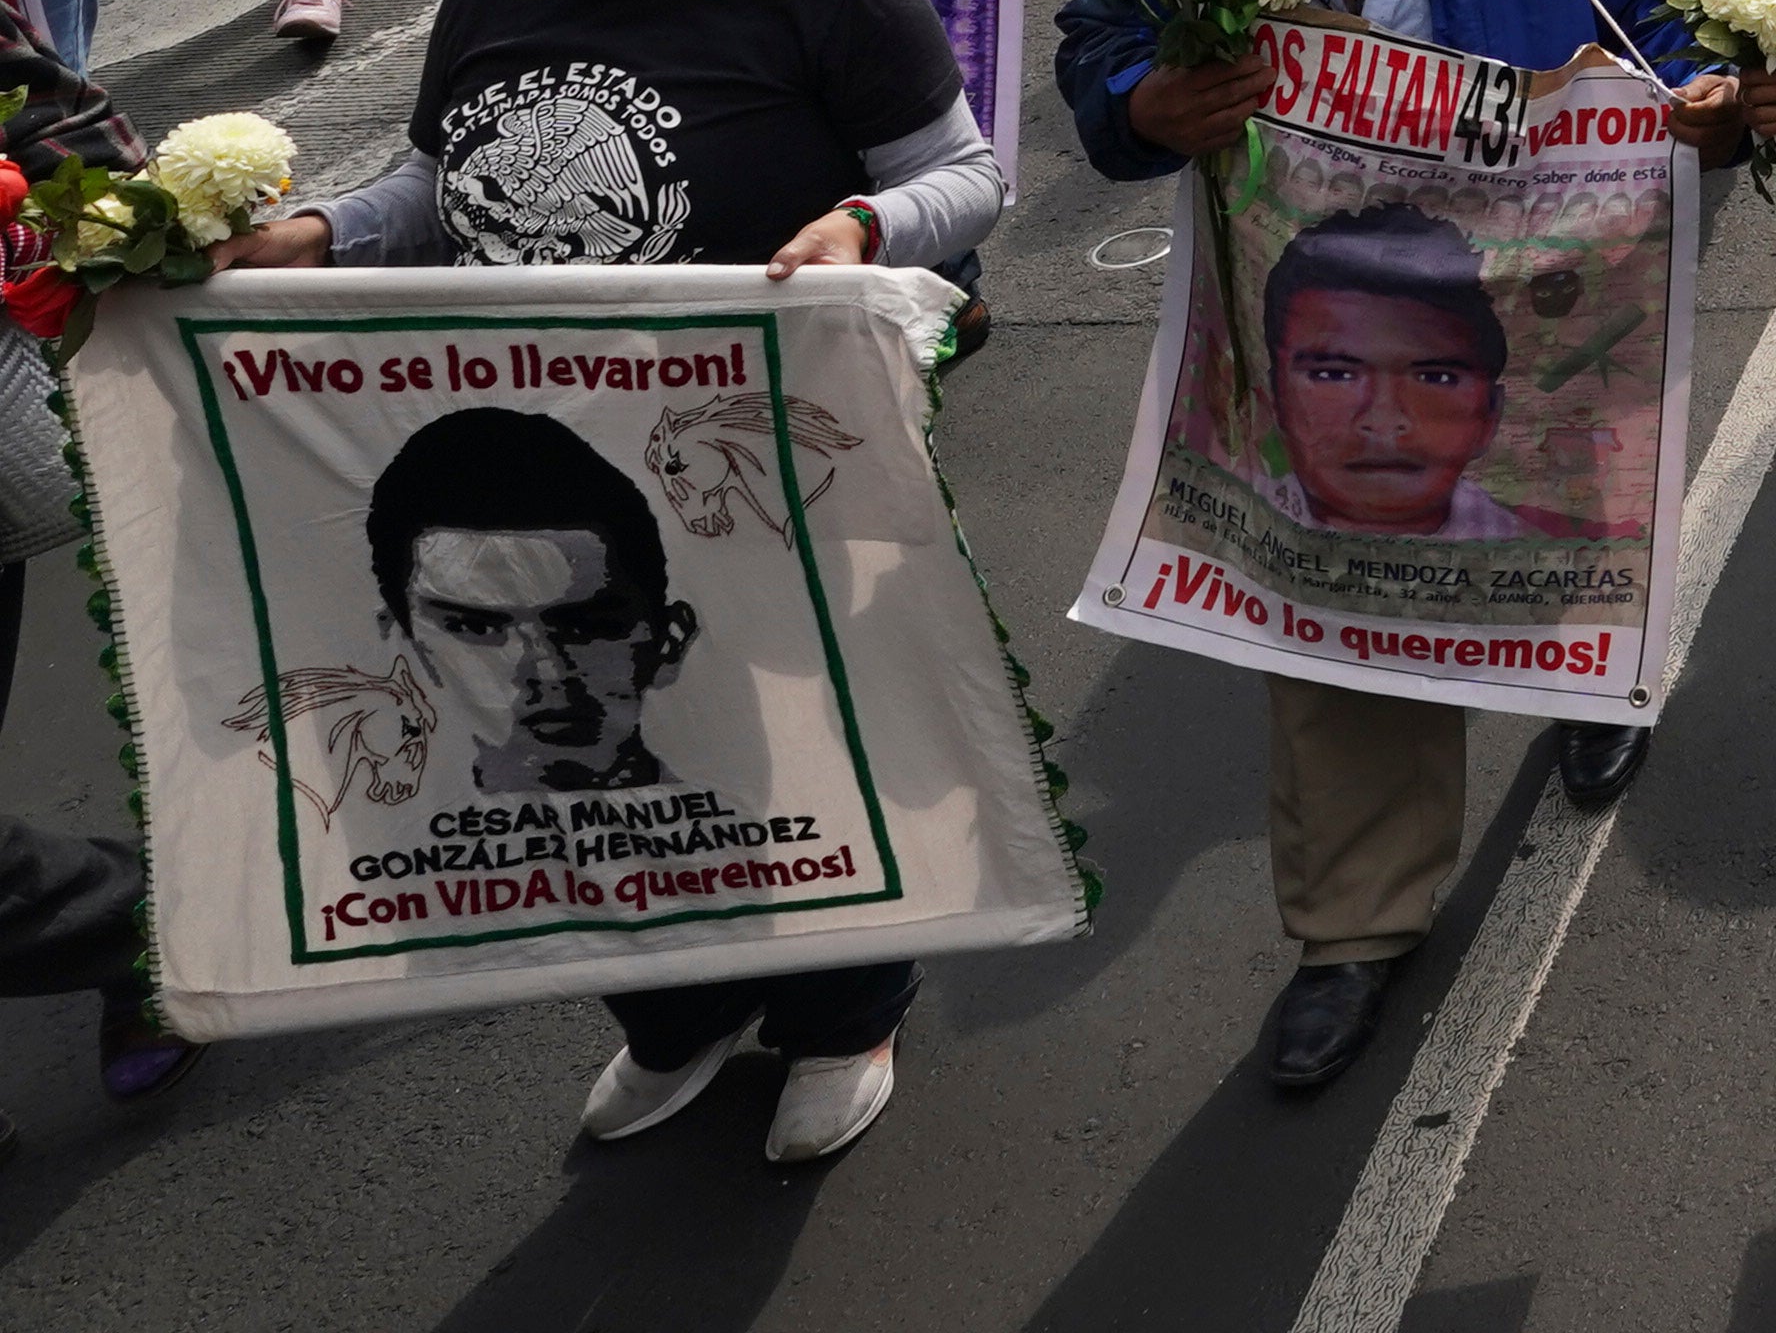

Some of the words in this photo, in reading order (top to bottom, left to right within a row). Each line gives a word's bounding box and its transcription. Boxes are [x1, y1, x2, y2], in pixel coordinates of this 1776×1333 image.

[441, 80, 507, 134] FUE
[517, 65, 557, 94] EL
[565, 61, 682, 130] ESTADO
[554, 83, 622, 111] SOMOS
[619, 103, 677, 169] TODOS
[1252, 23, 1306, 117] OS
[1306, 33, 1465, 152] FALTAN
[1455, 60, 1532, 168] 43!
[1378, 161, 1456, 185] Escocia,
[1468, 171, 1529, 190] quiero
[1533, 169, 1576, 185] saber
[1584, 165, 1627, 185] dónde
[1632, 162, 1668, 183] está
[224, 347, 364, 402] ¡Vivo
[379, 357, 433, 392] se
[446, 344, 499, 392] lo
[508, 342, 748, 393] llevaron!
[1169, 476, 1251, 535] MIGUEL
[1259, 530, 1330, 574] ÁNGEL
[1346, 558, 1471, 589] MENDOZA
[1489, 562, 1635, 591] ZACARÍAS
[1142, 554, 1269, 626] ¡Vivo
[1282, 603, 1325, 644] lo
[1339, 624, 1613, 678] queremos!
[349, 833, 568, 882] GONZÁLEZ
[576, 816, 822, 867] HERNÁNDEZ
[429, 805, 560, 838] CÉSAR
[570, 790, 735, 834] MANUEL
[321, 891, 427, 942] ¡Con
[434, 868, 556, 918] VIDA
[566, 870, 604, 907] lo
[615, 844, 857, 913] queremos!
